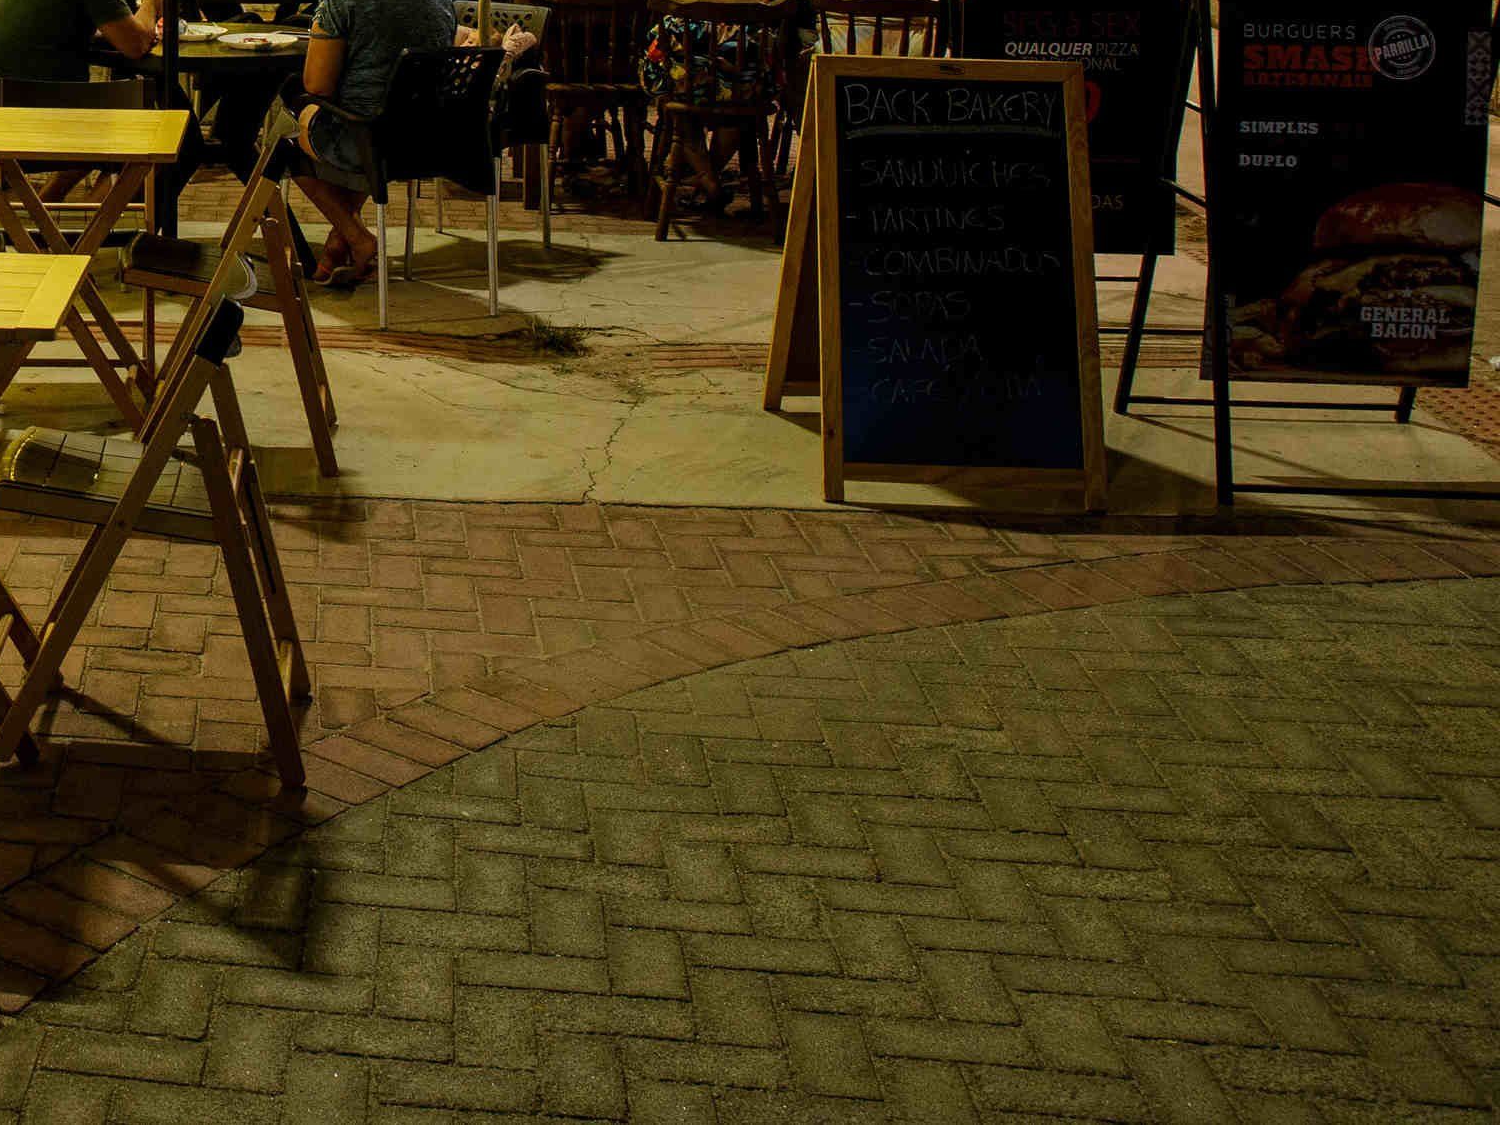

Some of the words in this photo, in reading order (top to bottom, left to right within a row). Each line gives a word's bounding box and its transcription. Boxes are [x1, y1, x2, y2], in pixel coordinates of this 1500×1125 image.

[1244, 23, 1356, 40] BURGUERS
[1004, 42, 1093, 56] QUALQUER
[1096, 43, 1140, 56] PIZZA
[1373, 34, 1430, 61] PARRILLA
[845, 84, 931, 124] BACK
[947, 87, 1056, 126] BAKERY
[1239, 121, 1319, 135] SIMPLES
[1239, 154, 1298, 168] DUPLO
[1360, 307, 1450, 324] GENERAL
[1370, 323, 1437, 339] BACON
